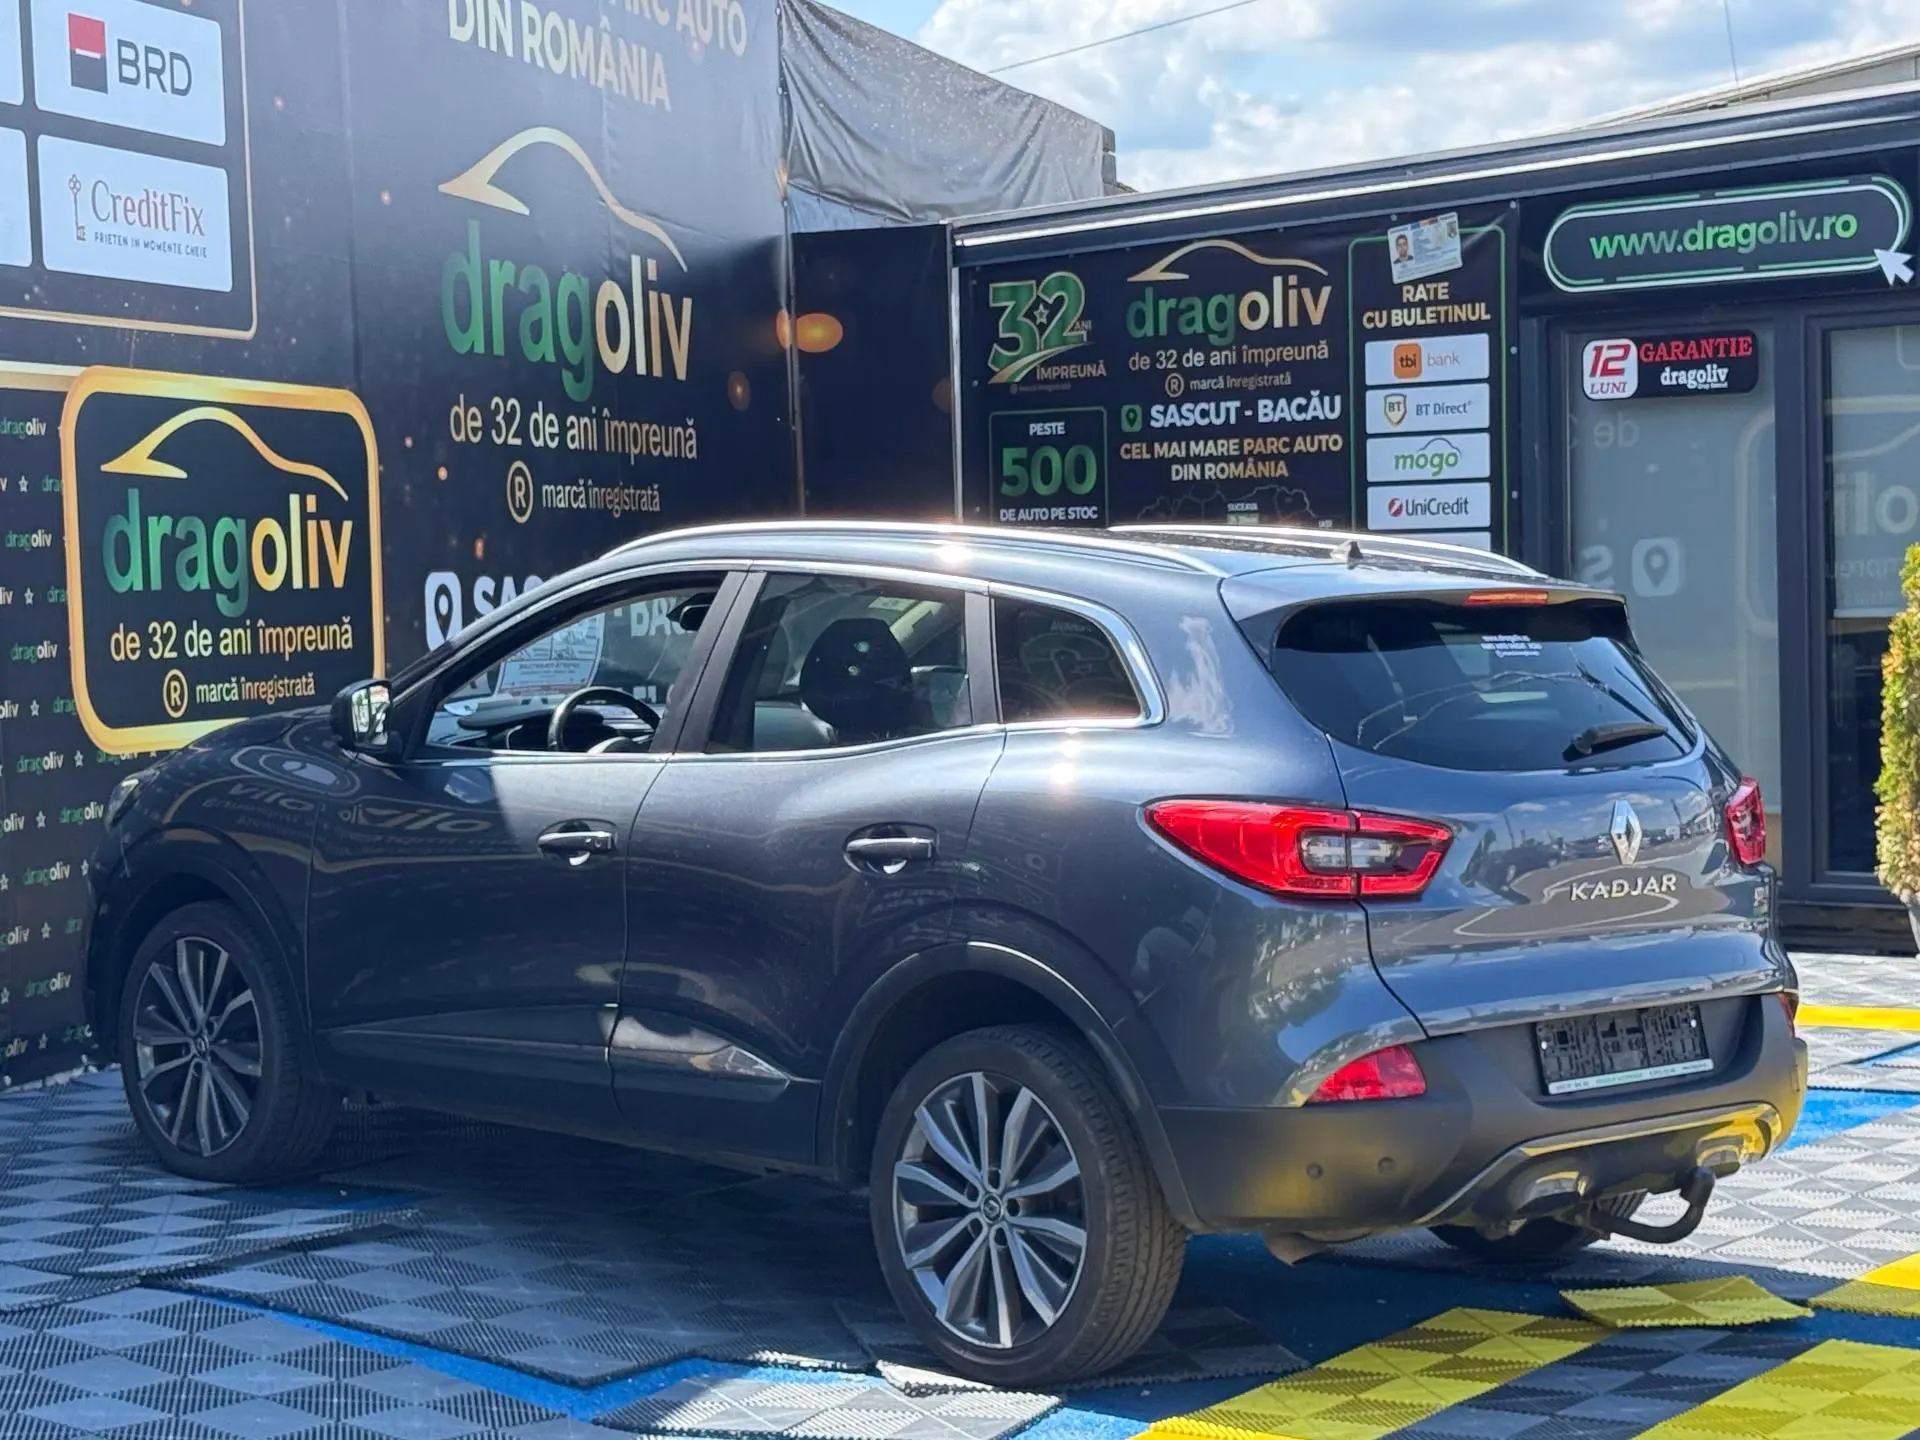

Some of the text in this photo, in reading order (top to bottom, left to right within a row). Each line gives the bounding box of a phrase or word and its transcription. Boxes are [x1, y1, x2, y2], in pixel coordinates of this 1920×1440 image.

[117, 38, 192, 97] BRD
[449, 0, 672, 112] DIN ROMÂNIA
[91, 179, 206, 237] CreditFix
[1589, 210, 1858, 259] www.dragoliv.ro
[1402, 282, 1450, 303] RATE
[441, 217, 693, 401] dragoliv
[987, 271, 1087, 374] 32
[1126, 275, 1332, 346] dragoliv
[1362, 302, 1492, 329] CU BULETINUL
[1128, 340, 1330, 371] de 32 de ani împreună
[1399, 352, 1461, 368] tbi bank
[1589, 344, 1631, 377] 12
[1639, 336, 1753, 363] GARANTIE
[1189, 375, 1225, 391] marcă
[1226, 371, 1292, 389] înregistrată
[1590, 381, 1628, 395] LUNI
[1660, 363, 1729, 389] dragoliv
[1150, 400, 1241, 429] SASCUT
[1257, 389, 1342, 423] BACĂU
[1387, 401, 1403, 413] BT
[1415, 403, 1467, 416] BT Direct
[450, 393, 698, 466] de 32 de ani împreună
[1029, 422, 1066, 436] PESTE
[1119, 433, 1344, 460] CEL MAI MARE PARC AUTO
[1001, 444, 1097, 497] 500
[1171, 457, 1289, 481] DIN ROMÂNIA
[1394, 452, 1459, 477] mogo
[542, 478, 587, 509] marcă
[588, 480, 661, 518] înregistrată
[1405, 497, 1469, 516] UniCredit
[1000, 505, 1099, 522] DE AUTO PE STOC
[5, 529, 52, 552] dragoliv
[103, 488, 354, 618] dragoliv
[11, 640, 58, 664] dragoliv
[110, 616, 353, 661] de 32 de ani împreună
[196, 677, 239, 704] marcă
[241, 672, 316, 705] înregistrată
[16, 751, 64, 775] dragoliv
[58, 801, 104, 825] dragoliv
[23, 861, 71, 886] dragoliv
[1570, 873, 1678, 902] KADJAR
